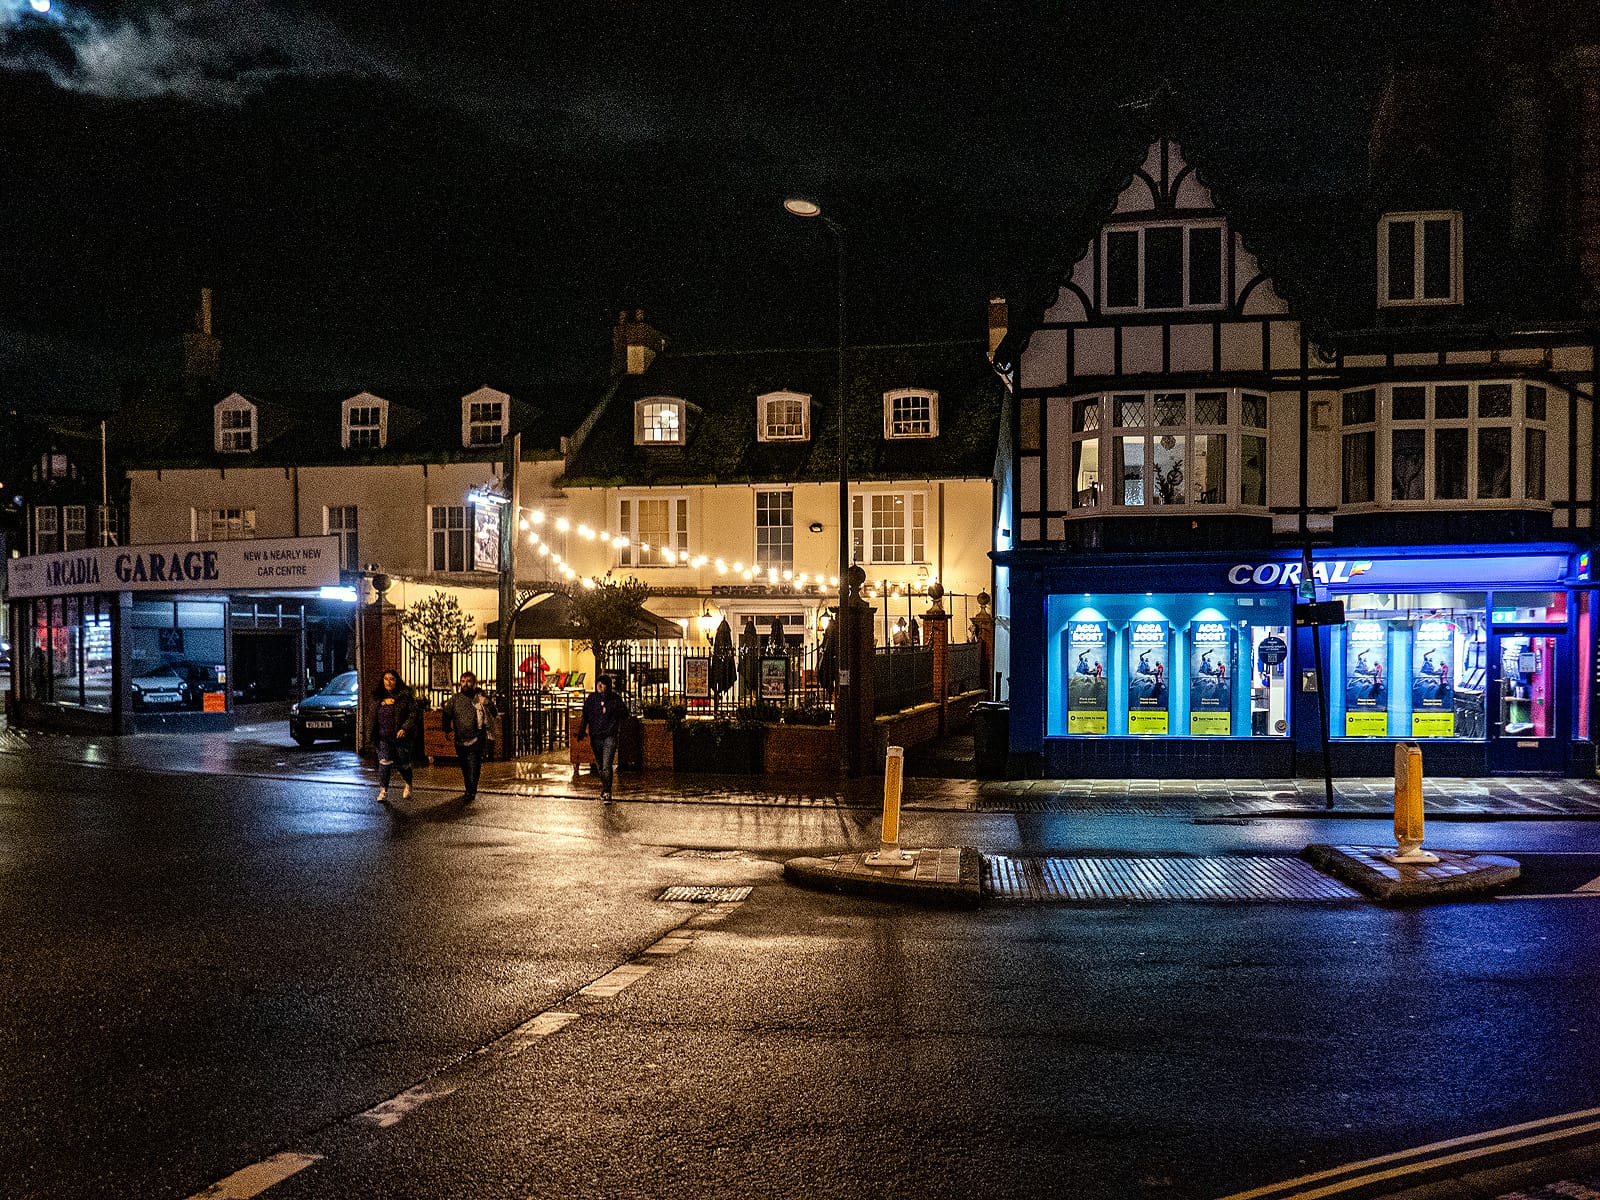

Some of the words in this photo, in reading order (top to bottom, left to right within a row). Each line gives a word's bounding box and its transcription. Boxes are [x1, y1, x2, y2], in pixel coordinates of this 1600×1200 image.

[243, 551, 261, 561] NEW
[270, 549, 301, 560] NEARLY
[303, 548, 321, 559] NEW
[46, 557, 100, 587] ARCADIA
[115, 551, 219, 582] GARAGE
[257, 566, 274, 576] CAR
[276, 565, 307, 576] CENTRE
[1228, 561, 1350, 585] CORAL
